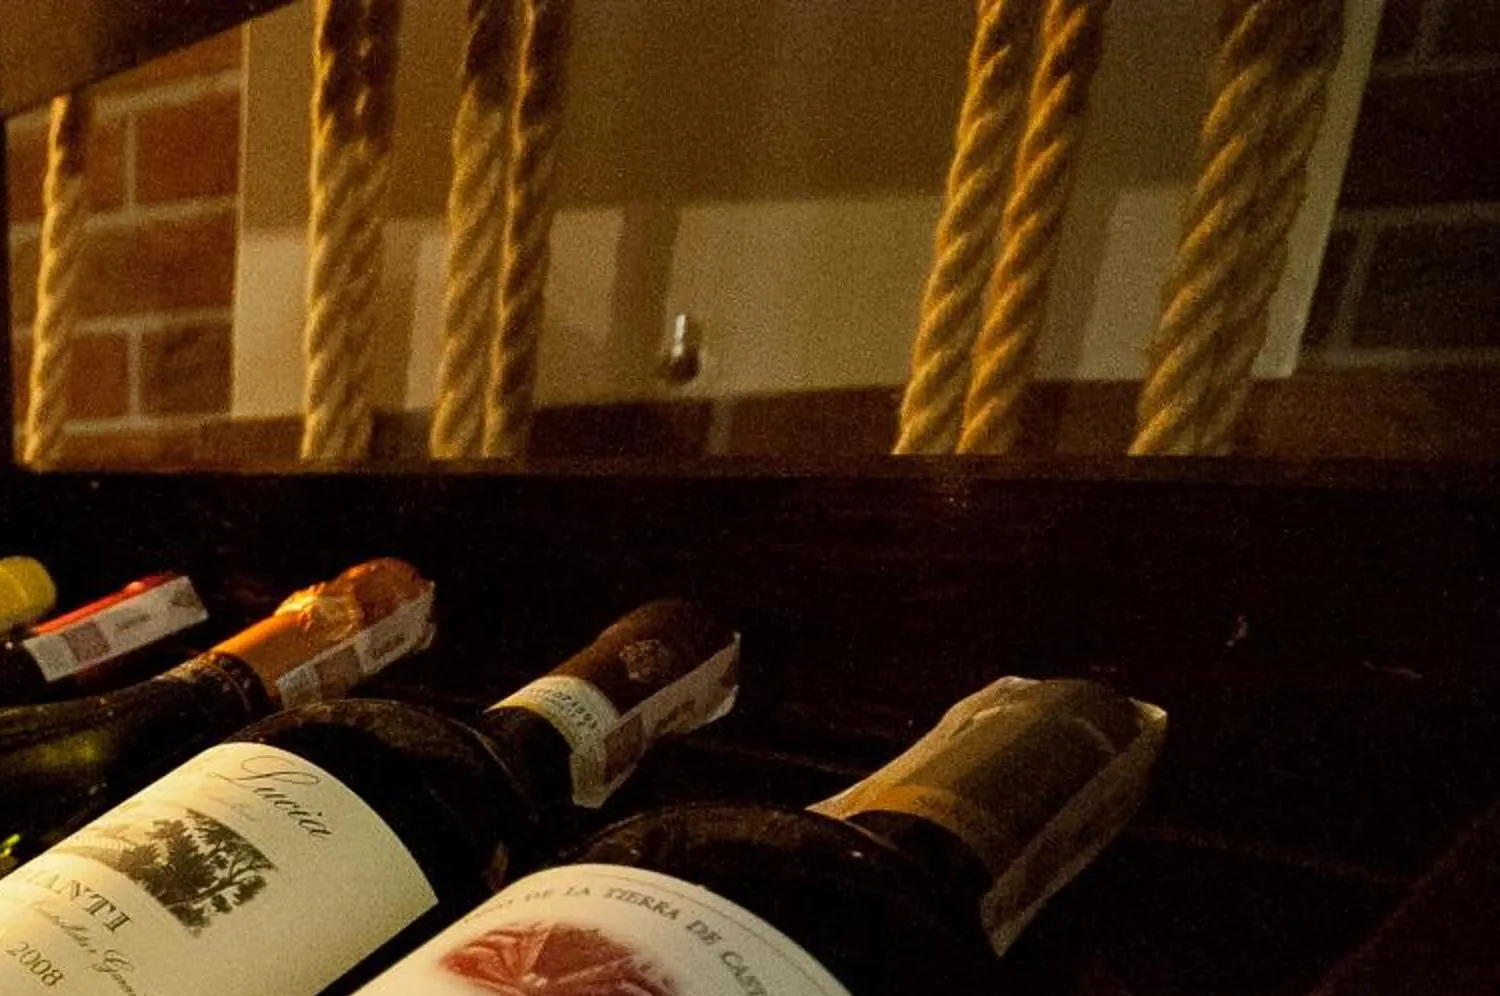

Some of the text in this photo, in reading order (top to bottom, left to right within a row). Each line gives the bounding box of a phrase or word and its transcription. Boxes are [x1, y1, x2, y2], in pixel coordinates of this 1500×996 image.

[206, 755, 332, 838] Lucia
[603, 886, 681, 922] TIERRA
[685, 918, 723, 947] DE
[5, 941, 65, 988] 2008
